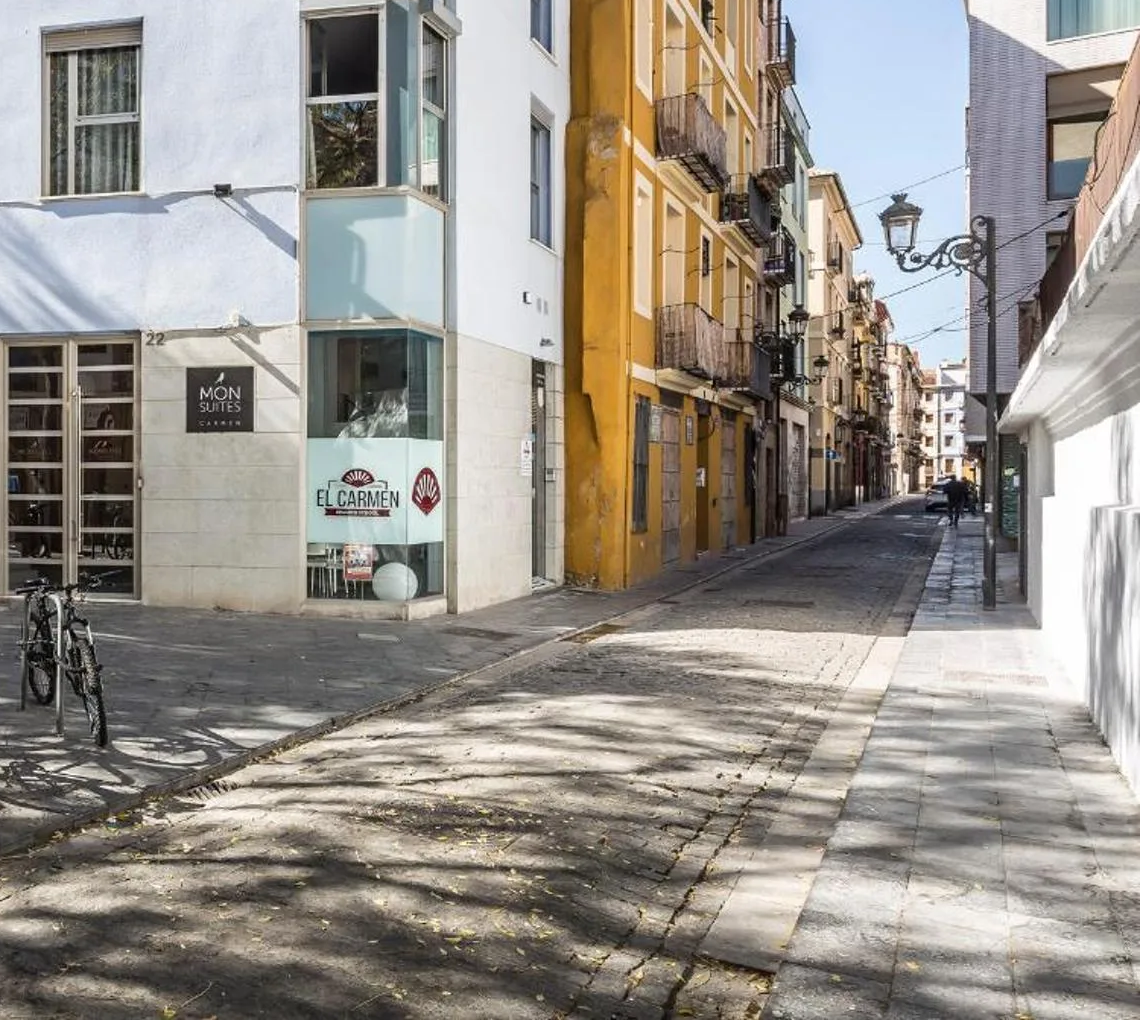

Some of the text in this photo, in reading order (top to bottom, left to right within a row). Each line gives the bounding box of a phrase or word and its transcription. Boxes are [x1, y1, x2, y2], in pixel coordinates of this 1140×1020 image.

[145, 332, 165, 346] 22
[200, 385, 241, 400] MON
[199, 400, 241, 413] SUITES
[316, 489, 400, 509] EL CARMEN
